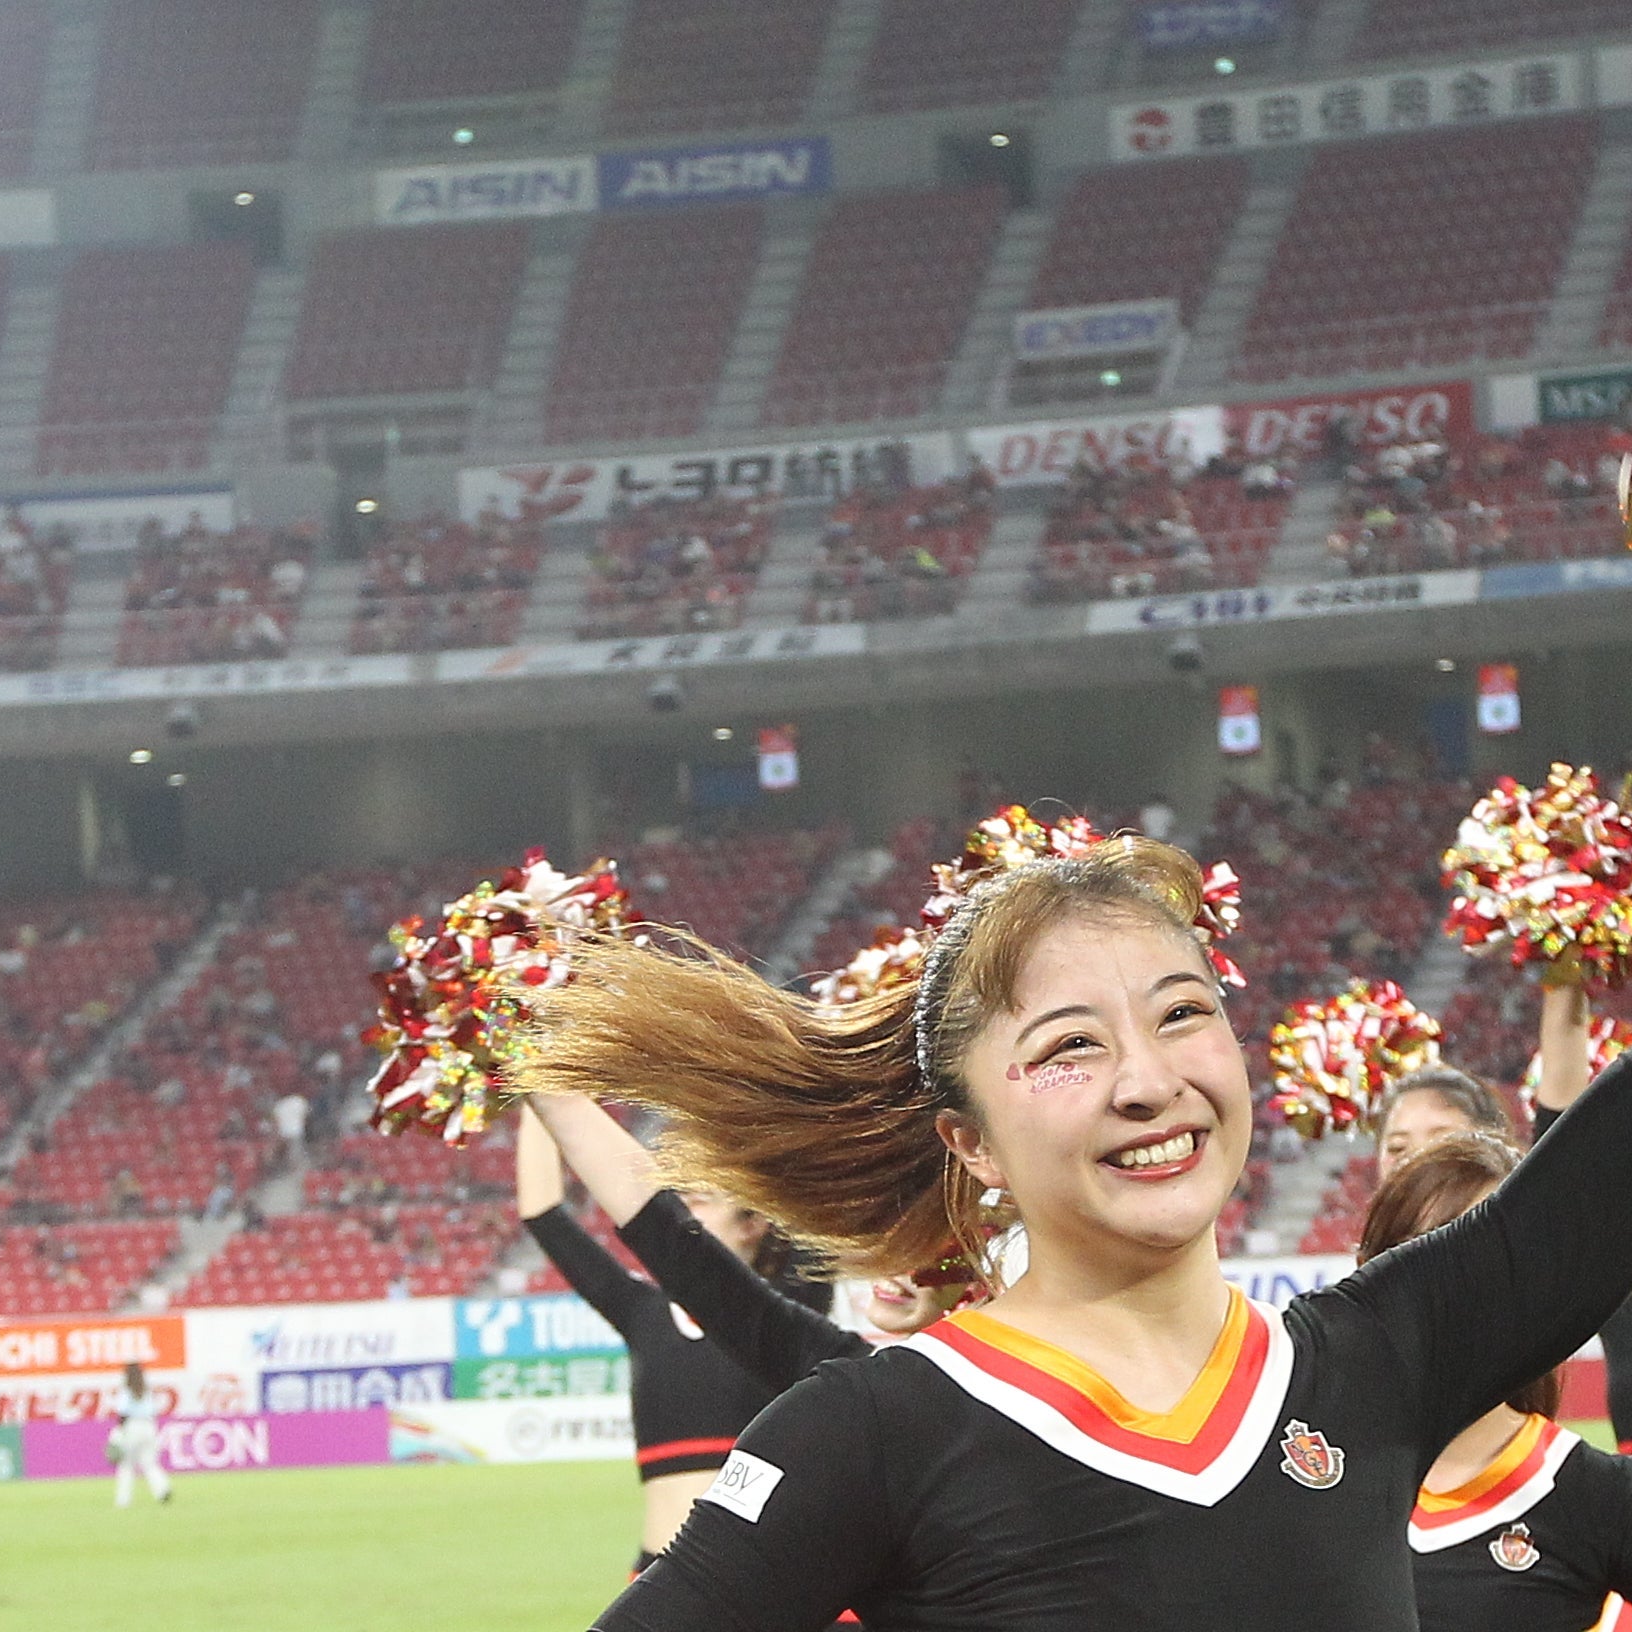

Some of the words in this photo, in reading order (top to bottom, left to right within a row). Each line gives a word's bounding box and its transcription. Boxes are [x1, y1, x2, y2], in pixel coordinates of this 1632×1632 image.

[393, 168, 582, 214] AISIN
[618, 147, 813, 198] AISIN
[68, 1326, 159, 1365] STEEL
